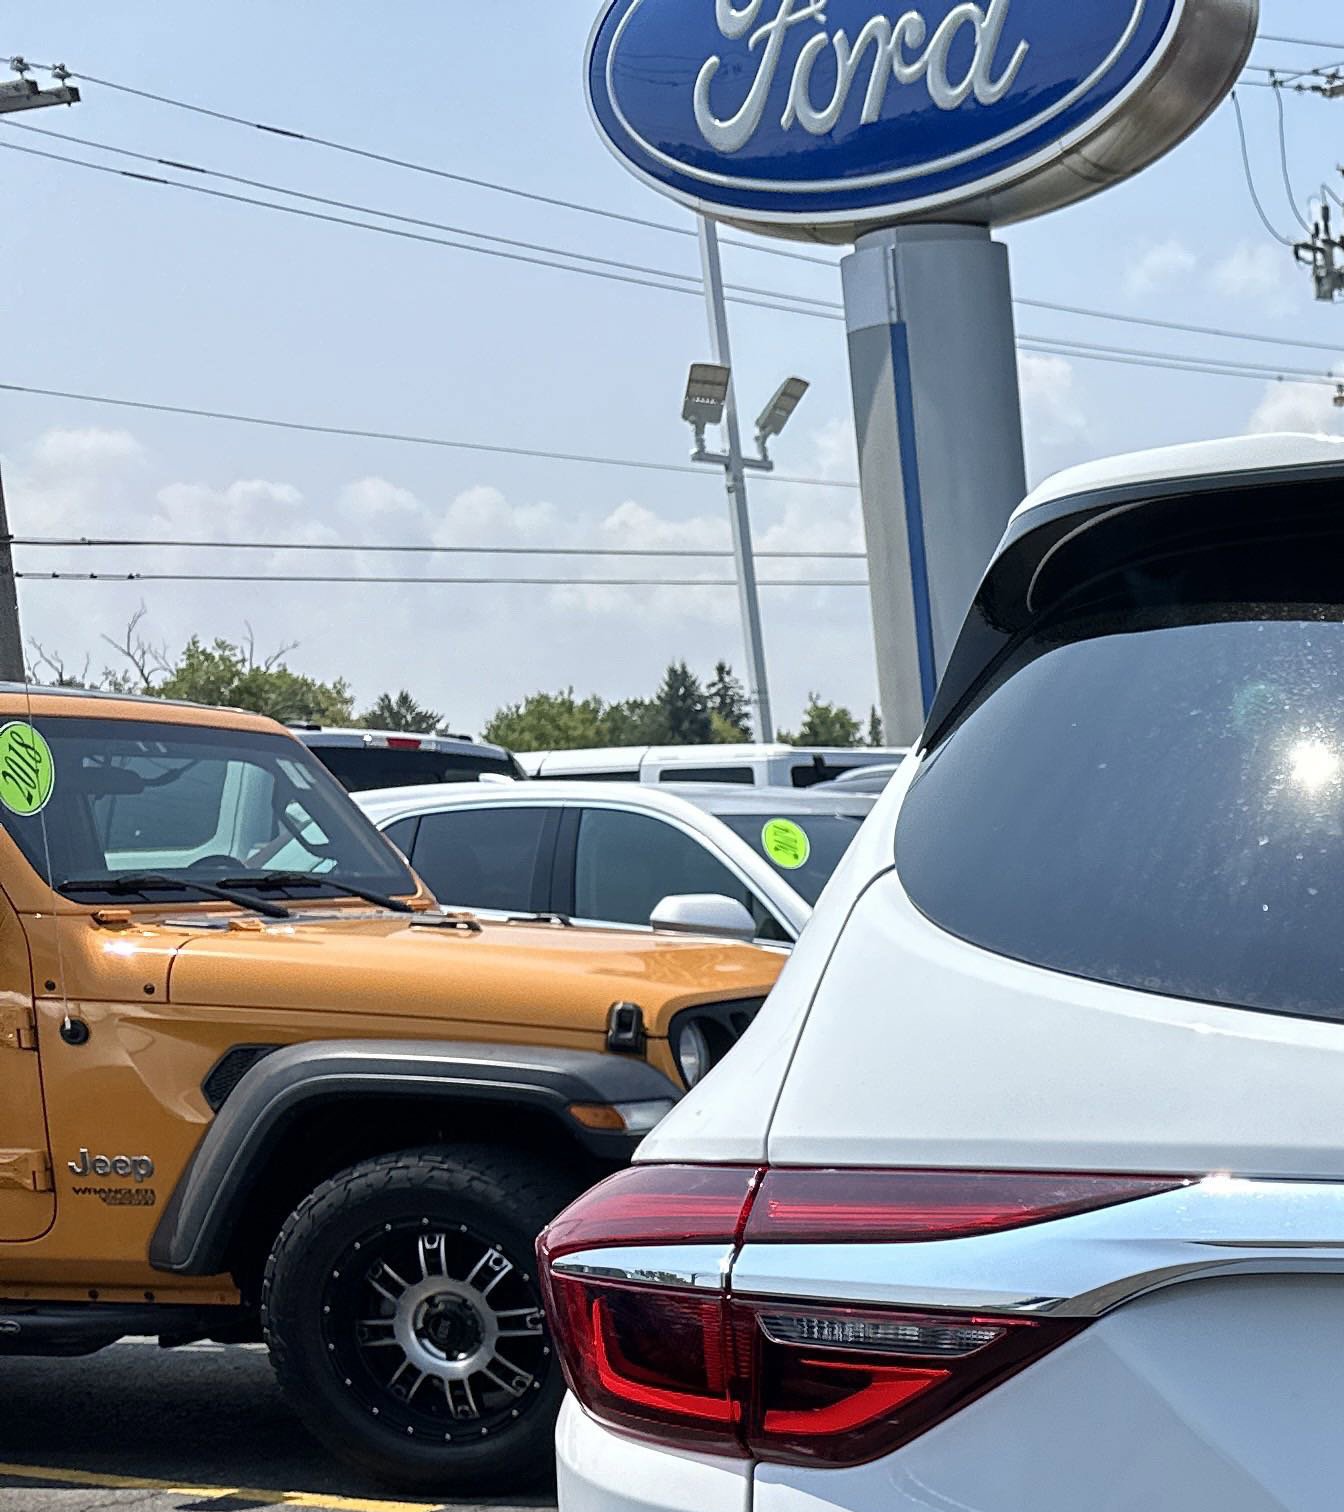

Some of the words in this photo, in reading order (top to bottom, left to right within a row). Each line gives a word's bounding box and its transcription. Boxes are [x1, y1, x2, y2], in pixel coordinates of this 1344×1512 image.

[693, 0, 1030, 153] Ford
[2, 730, 42, 806] 2018
[67, 1146, 155, 1184] Jeep
